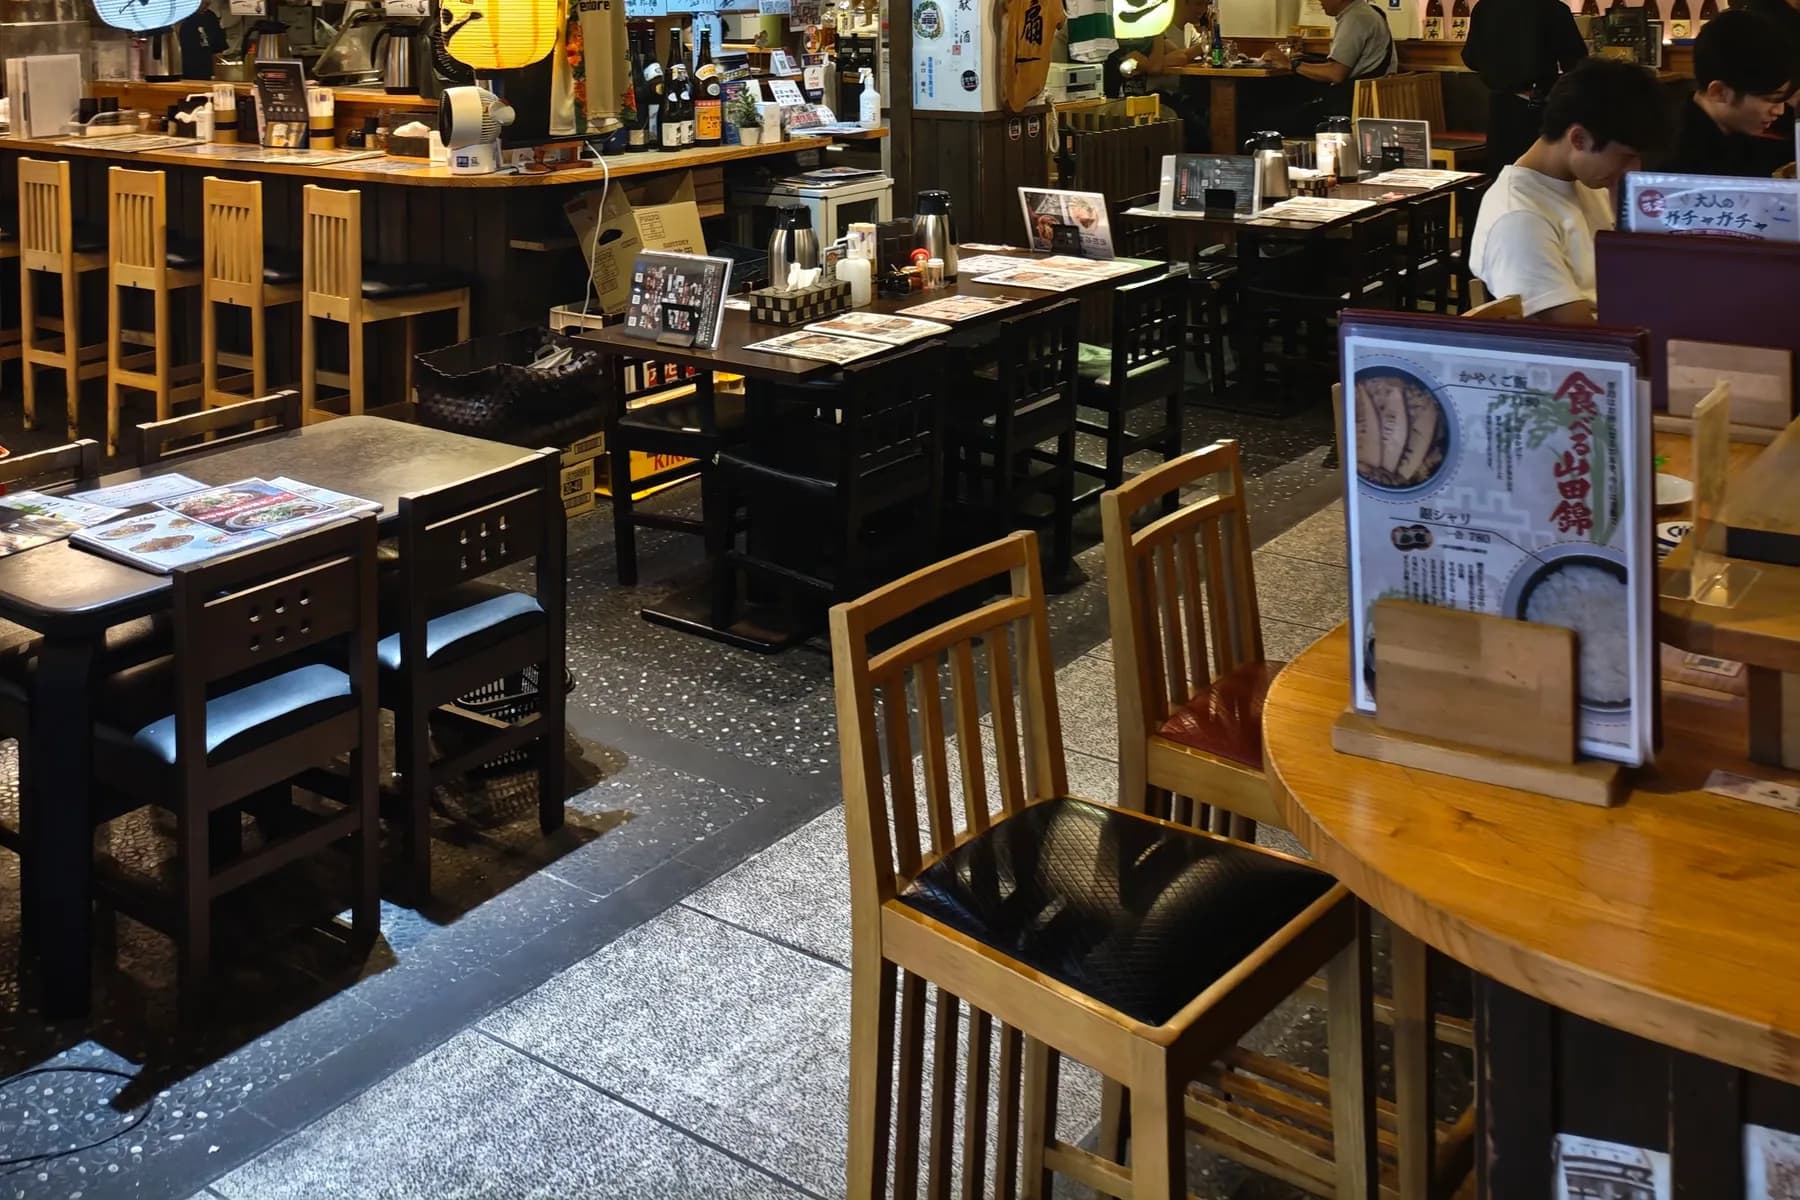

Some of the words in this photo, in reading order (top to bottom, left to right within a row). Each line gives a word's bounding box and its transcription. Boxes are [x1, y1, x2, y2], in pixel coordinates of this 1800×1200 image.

[1549, 371, 1605, 537] 食べる山田錦
